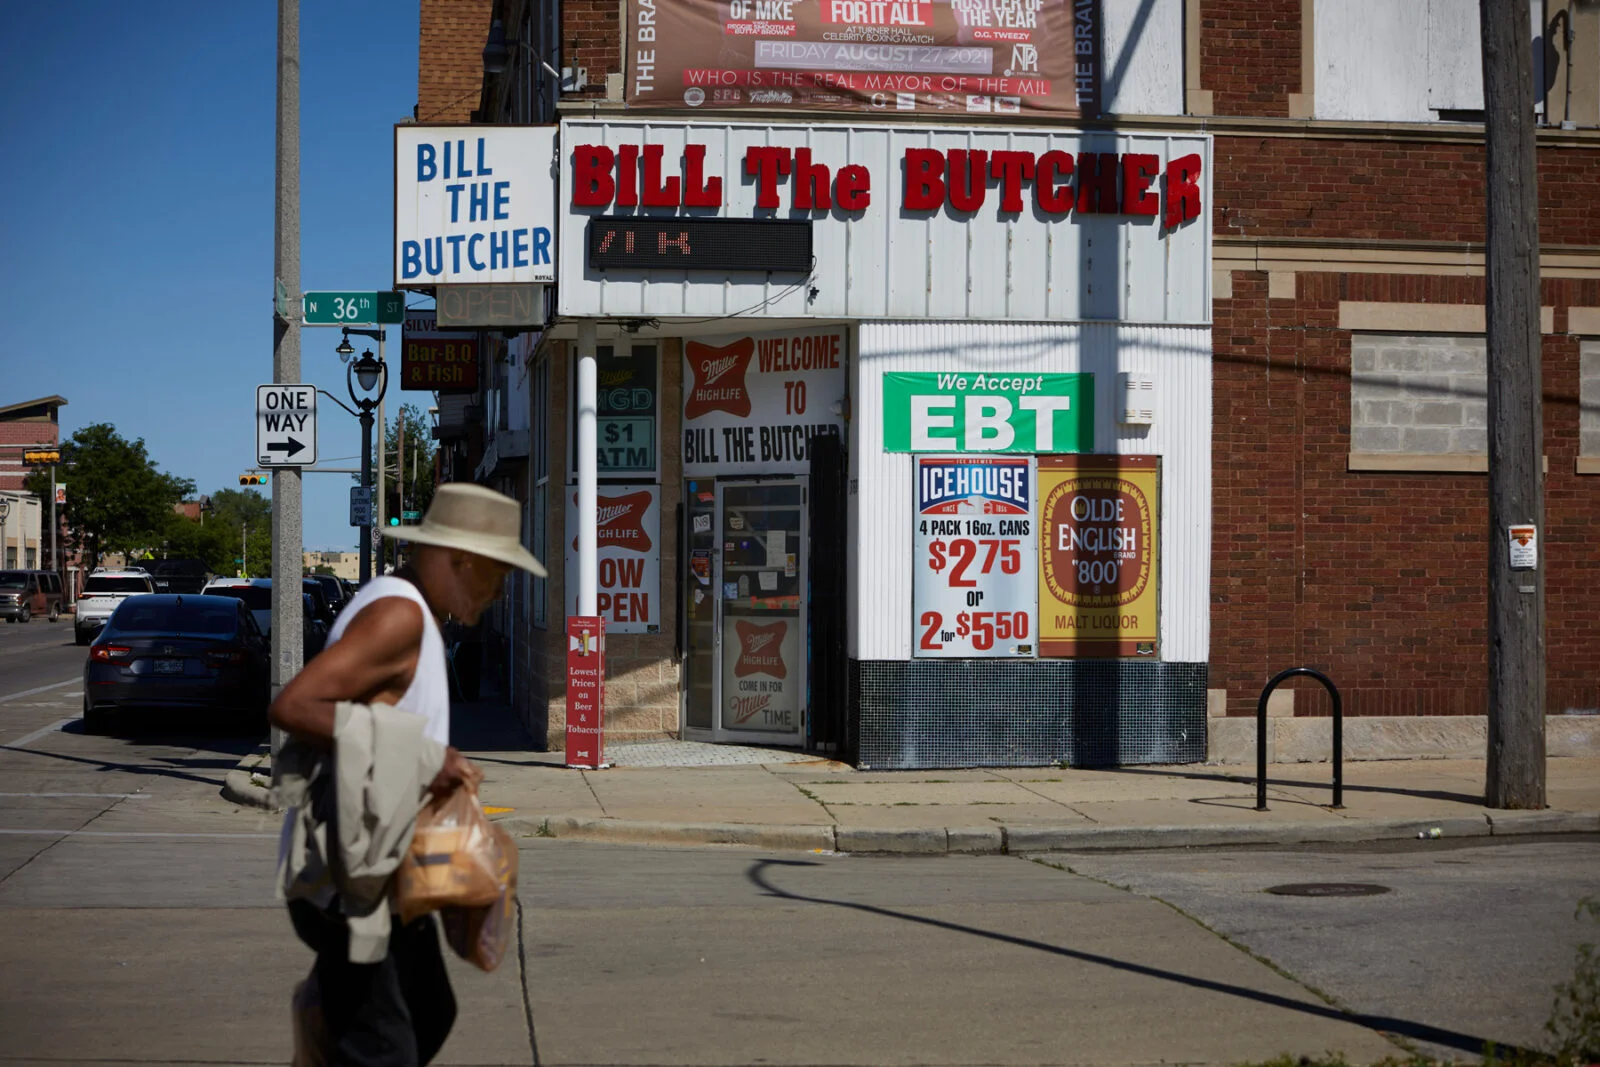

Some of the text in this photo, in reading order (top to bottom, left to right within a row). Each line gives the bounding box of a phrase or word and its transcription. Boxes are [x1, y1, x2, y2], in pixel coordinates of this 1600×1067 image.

[730, 1, 793, 20] OF MKE
[832, 1, 925, 25] FOR IT ALL
[951, 0, 1044, 12] HUSTLER OF
[961, 9, 1037, 28] THE YEAR
[823, 32, 935, 44] CELEBRITY BOXING MATCH
[846, 26, 912, 36] AT TURNER HALL
[994, 32, 1030, 40] TWEEZY
[760, 42, 832, 60] FRIDAY
[834, 44, 917, 62] AUGUST
[948, 48, 987, 64] 2021
[636, 50, 655, 96] THE
[688, 71, 1047, 95] WHO IS THE REAL MAYOR OF THE MIL
[1075, 63, 1094, 107] THE
[417, 138, 493, 182] BILL
[573, 144, 1202, 229] BILL The BUTCHER
[446, 181, 510, 223] THE
[401, 227, 551, 279] BUTCHER
[310, 302, 317, 313] N
[387, 302, 398, 313] ST
[443, 288, 531, 319] OPEN
[406, 319, 438, 332] SILVE
[758, 335, 840, 373] WELCOME
[412, 364, 463, 382] & Fish
[702, 354, 740, 385] Miller
[937, 374, 1043, 394] We Accept
[265, 391, 308, 410] ONE
[696, 388, 741, 401] HIGH LIFE
[784, 380, 806, 416] TO
[265, 414, 308, 432] WAY
[910, 395, 1070, 451] EBT
[604, 422, 634, 444] $1
[685, 427, 719, 464] BILL
[722, 425, 755, 463] THE
[923, 467, 1025, 503] ICEHOUSE
[1070, 495, 1125, 522] OLDE
[616, 529, 639, 538] LIFE
[919, 520, 1030, 536] 4 PACK 16oz. CANS
[1058, 523, 1136, 556] ENGLISH
[1114, 551, 1136, 559] BRAND
[599, 558, 645, 588] OW
[1072, 559, 1123, 585] "800"
[576, 593, 648, 622] PEN
[966, 591, 984, 607] or
[920, 611, 943, 650] 2
[941, 629, 955, 642] for
[1055, 615, 1138, 629] MALT LIQUOR
[743, 655, 778, 665] HIGH LIFE
[570, 667, 597, 675] Lowest
[572, 678, 595, 687] Prices
[739, 680, 783, 692] COME IN FOR
[574, 702, 592, 710] Beer
[730, 694, 772, 724] Miller
[580, 714, 586, 722] &
[762, 710, 791, 725] TIME
[567, 725, 599, 734] Tobacco
